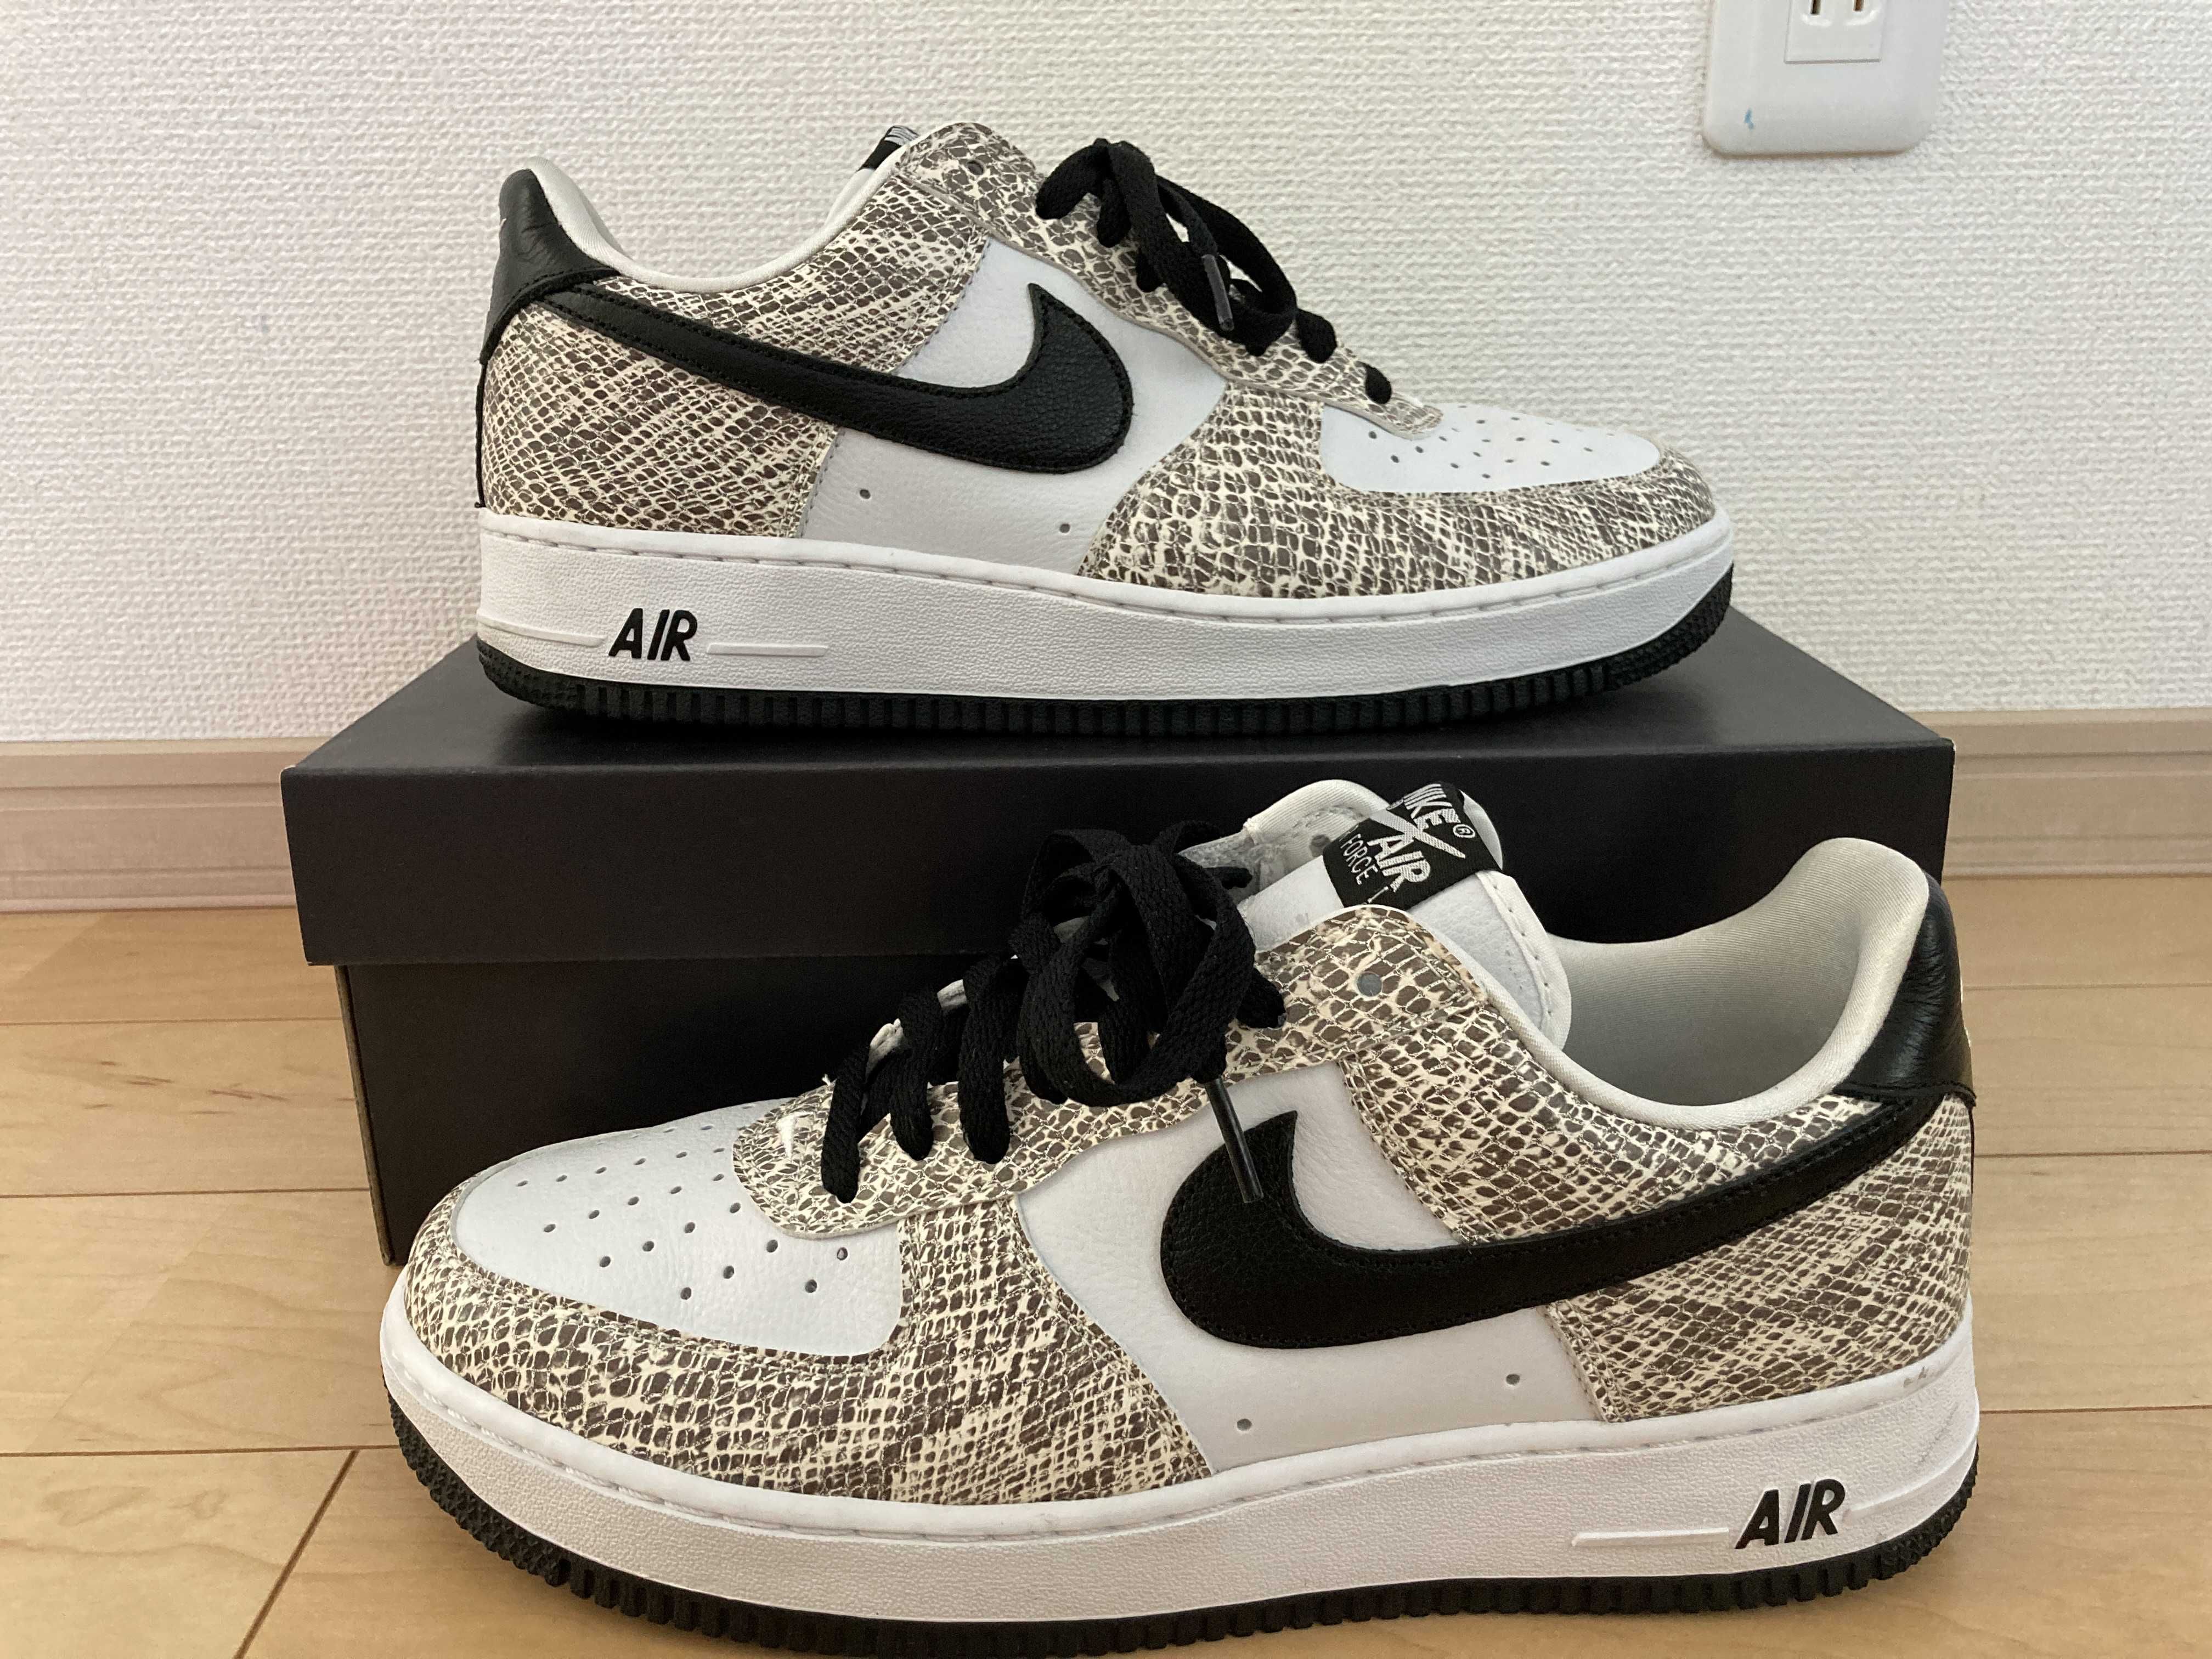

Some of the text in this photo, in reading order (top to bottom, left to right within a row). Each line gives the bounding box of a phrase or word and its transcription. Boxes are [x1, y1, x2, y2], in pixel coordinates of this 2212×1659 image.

[608, 608, 697, 661] AIR
[1340, 833, 1378, 885] FORCE
[1367, 830, 1431, 893] AIR
[1734, 1479, 1846, 1550] AIR
